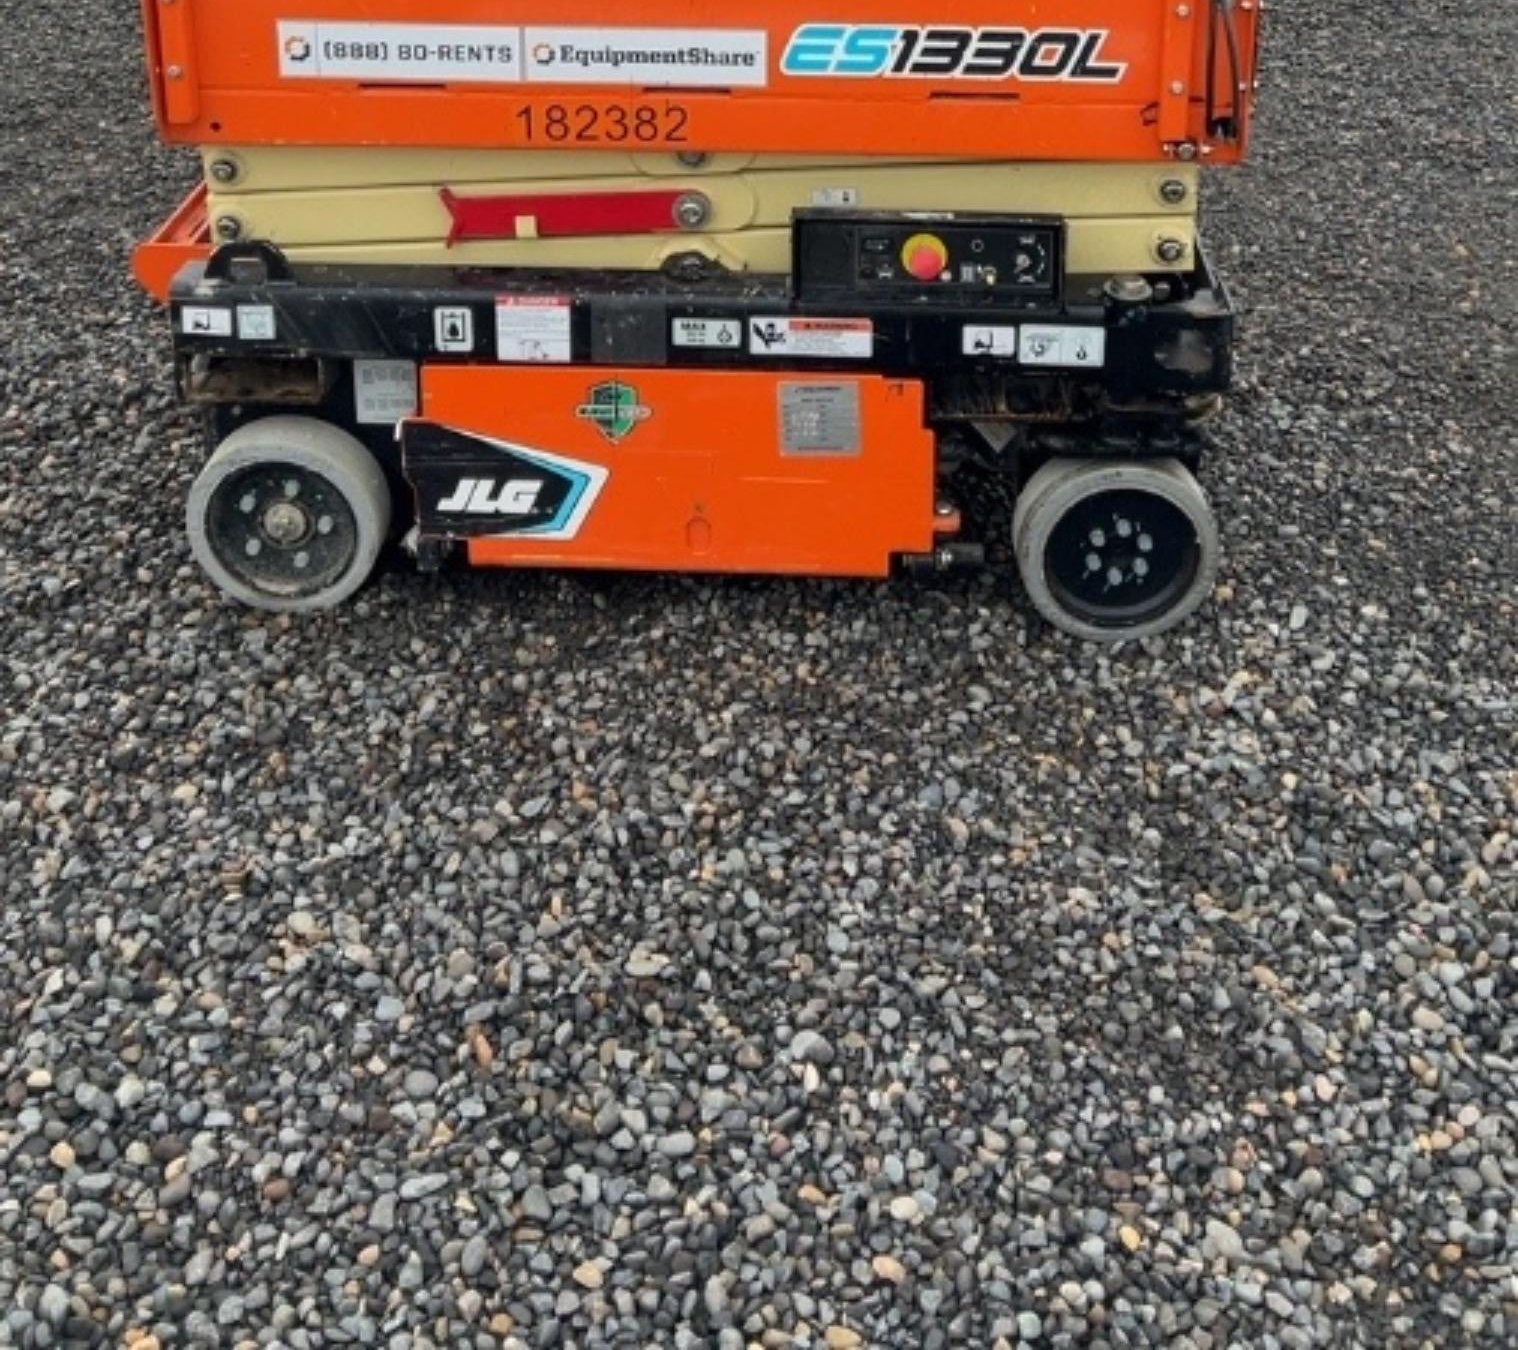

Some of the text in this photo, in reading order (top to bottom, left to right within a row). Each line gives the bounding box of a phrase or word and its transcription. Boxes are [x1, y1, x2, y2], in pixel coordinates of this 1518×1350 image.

[323, 40, 388, 61] (888)
[559, 44, 756, 67] EquipmentShare
[782, 24, 1126, 82] ES1330L
[516, 104, 689, 142] 182382
[437, 478, 544, 514] JLG
